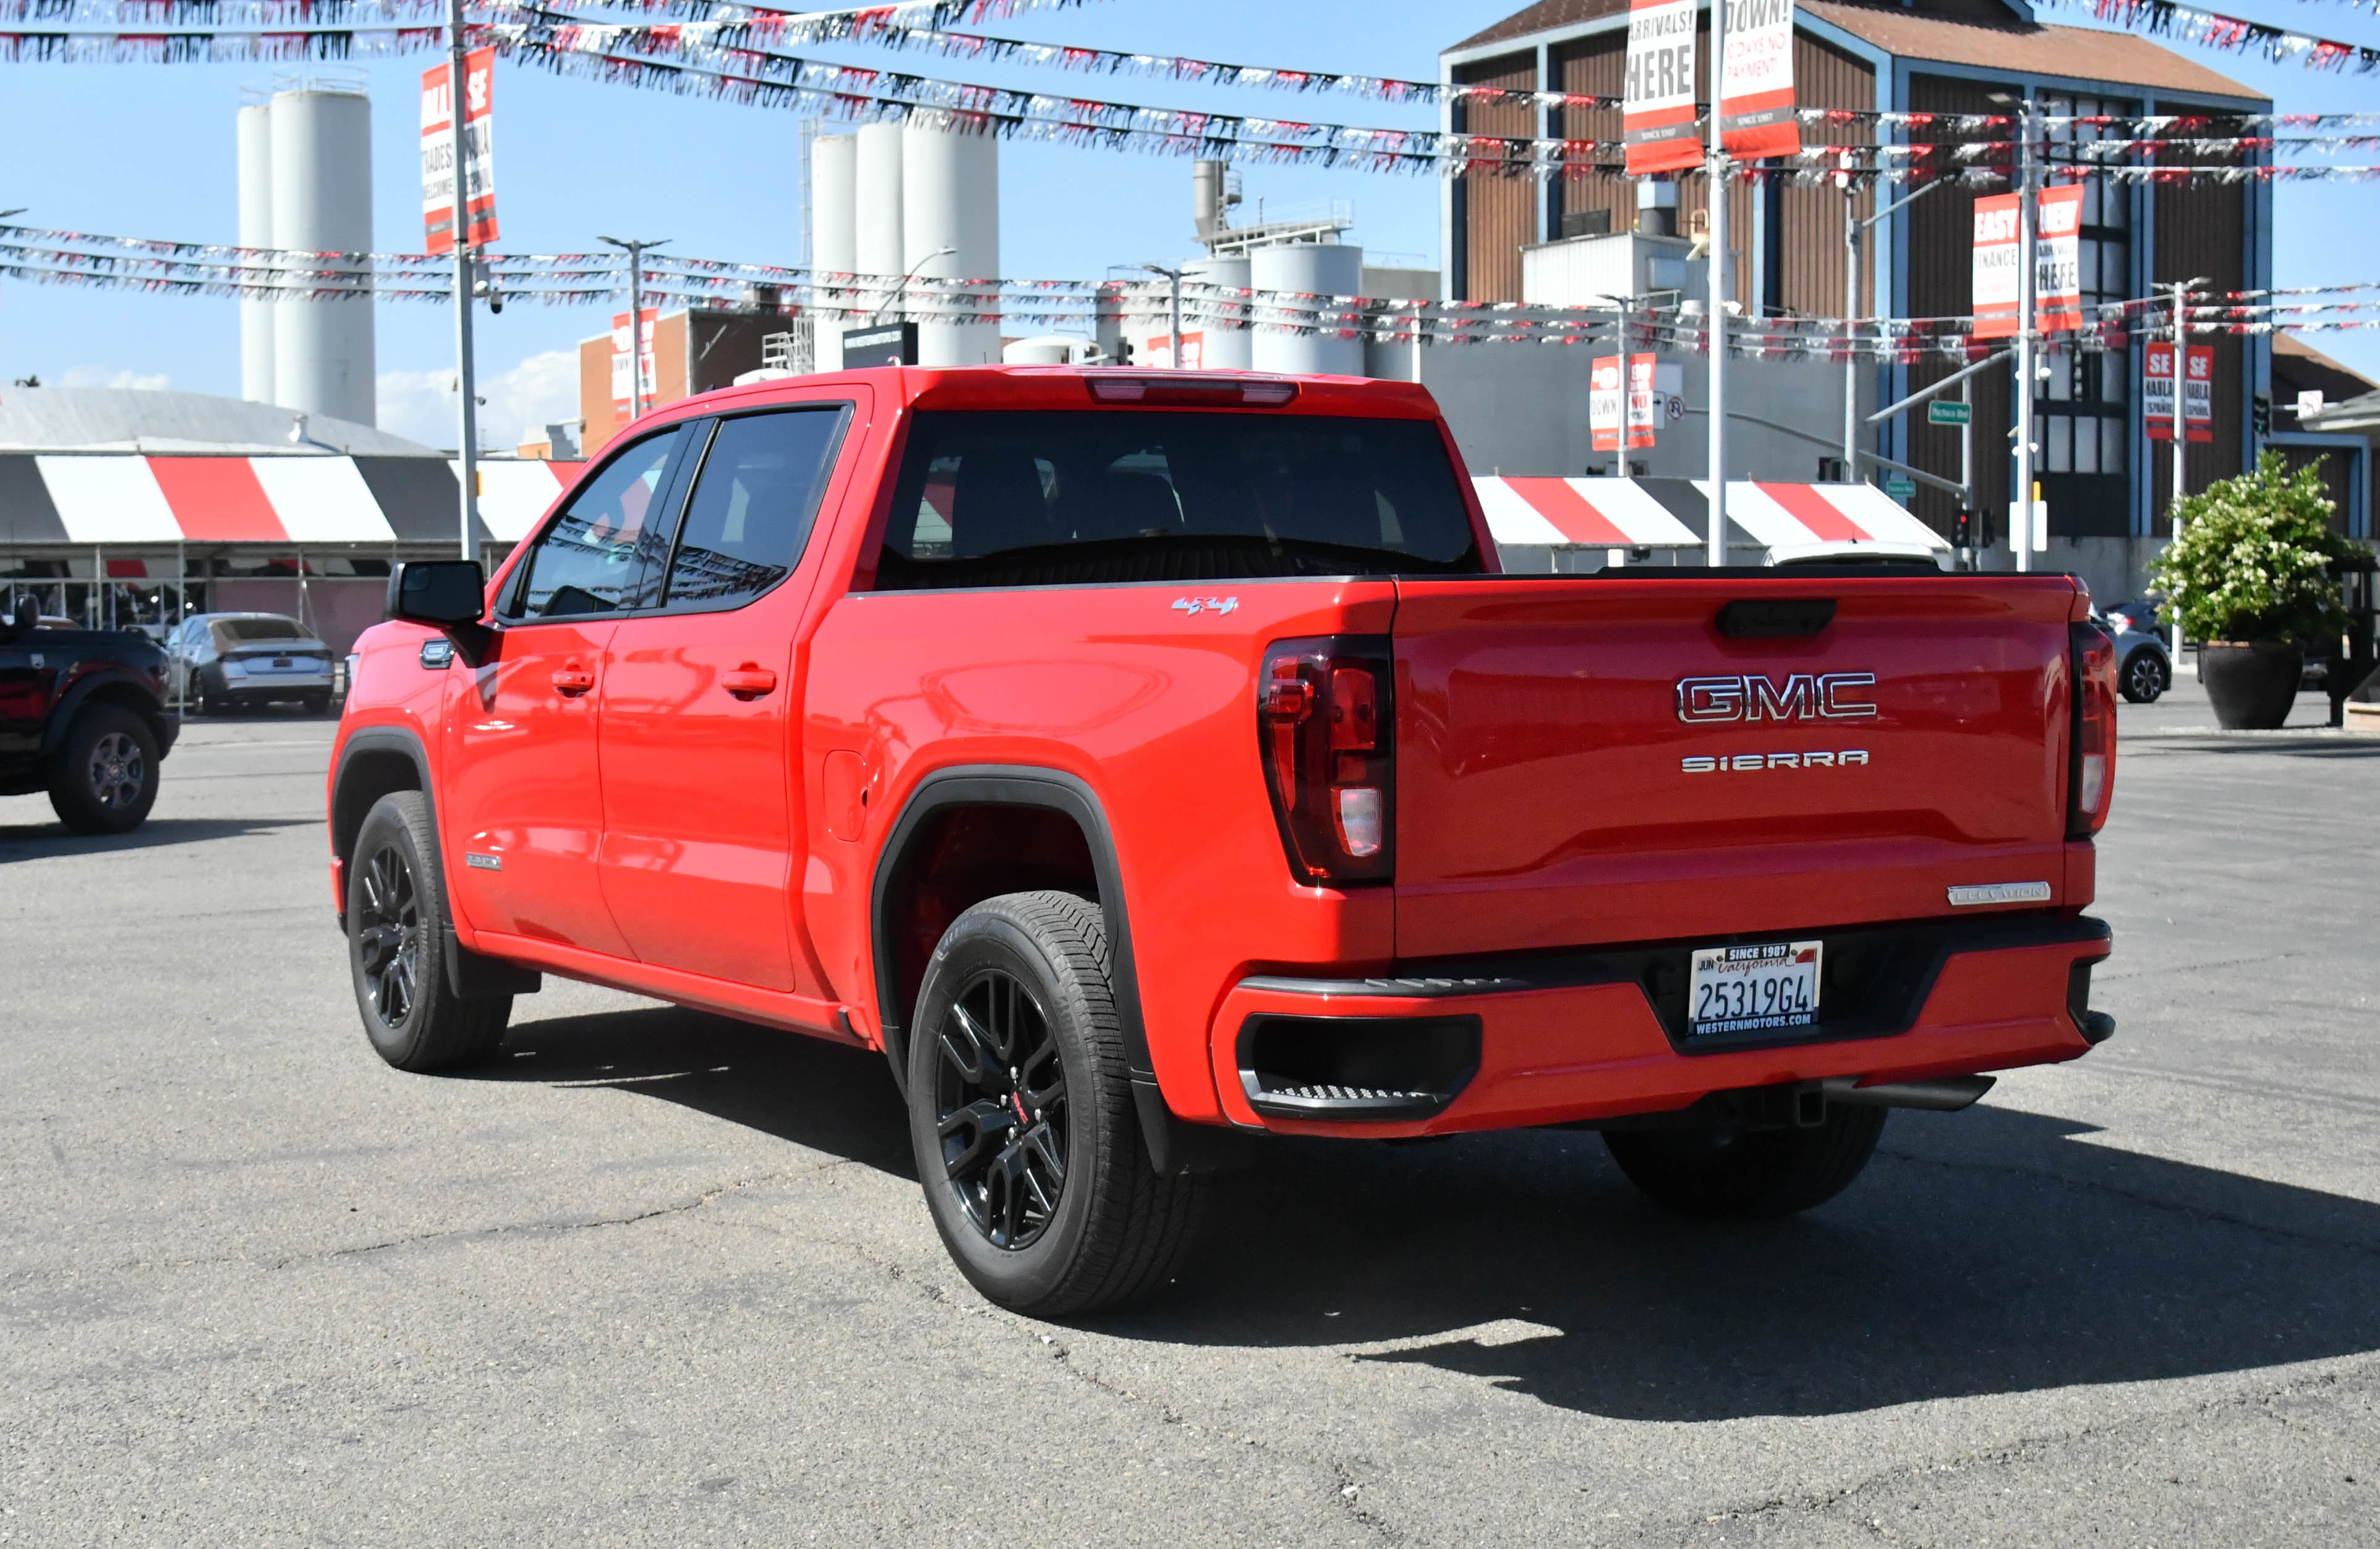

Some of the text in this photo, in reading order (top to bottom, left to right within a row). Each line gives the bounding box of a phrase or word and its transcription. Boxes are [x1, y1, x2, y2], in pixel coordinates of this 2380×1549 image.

[1630, 9, 1693, 41] ARRIVALS!
[1736, 38, 1764, 57] DAYS
[1768, 32, 1786, 50] NO
[1627, 44, 1691, 103] HERE
[421, 84, 451, 128] ALL
[1975, 208, 2018, 242] EASY
[2039, 262, 2076, 291] HERE
[2149, 353, 2170, 374] SE
[2189, 356, 2208, 378] SE
[1676, 672, 1877, 723] GMC
[1681, 749, 1869, 773] SIERRA
[1955, 887, 2042, 901] ELEVATION
[1699, 960, 1714, 971] JUN
[1729, 945, 1787, 961] SINCE 1987
[1698, 975, 1808, 1021] 25319G4
[1696, 1013, 1811, 1035] WESTERNMOTORS.COM
